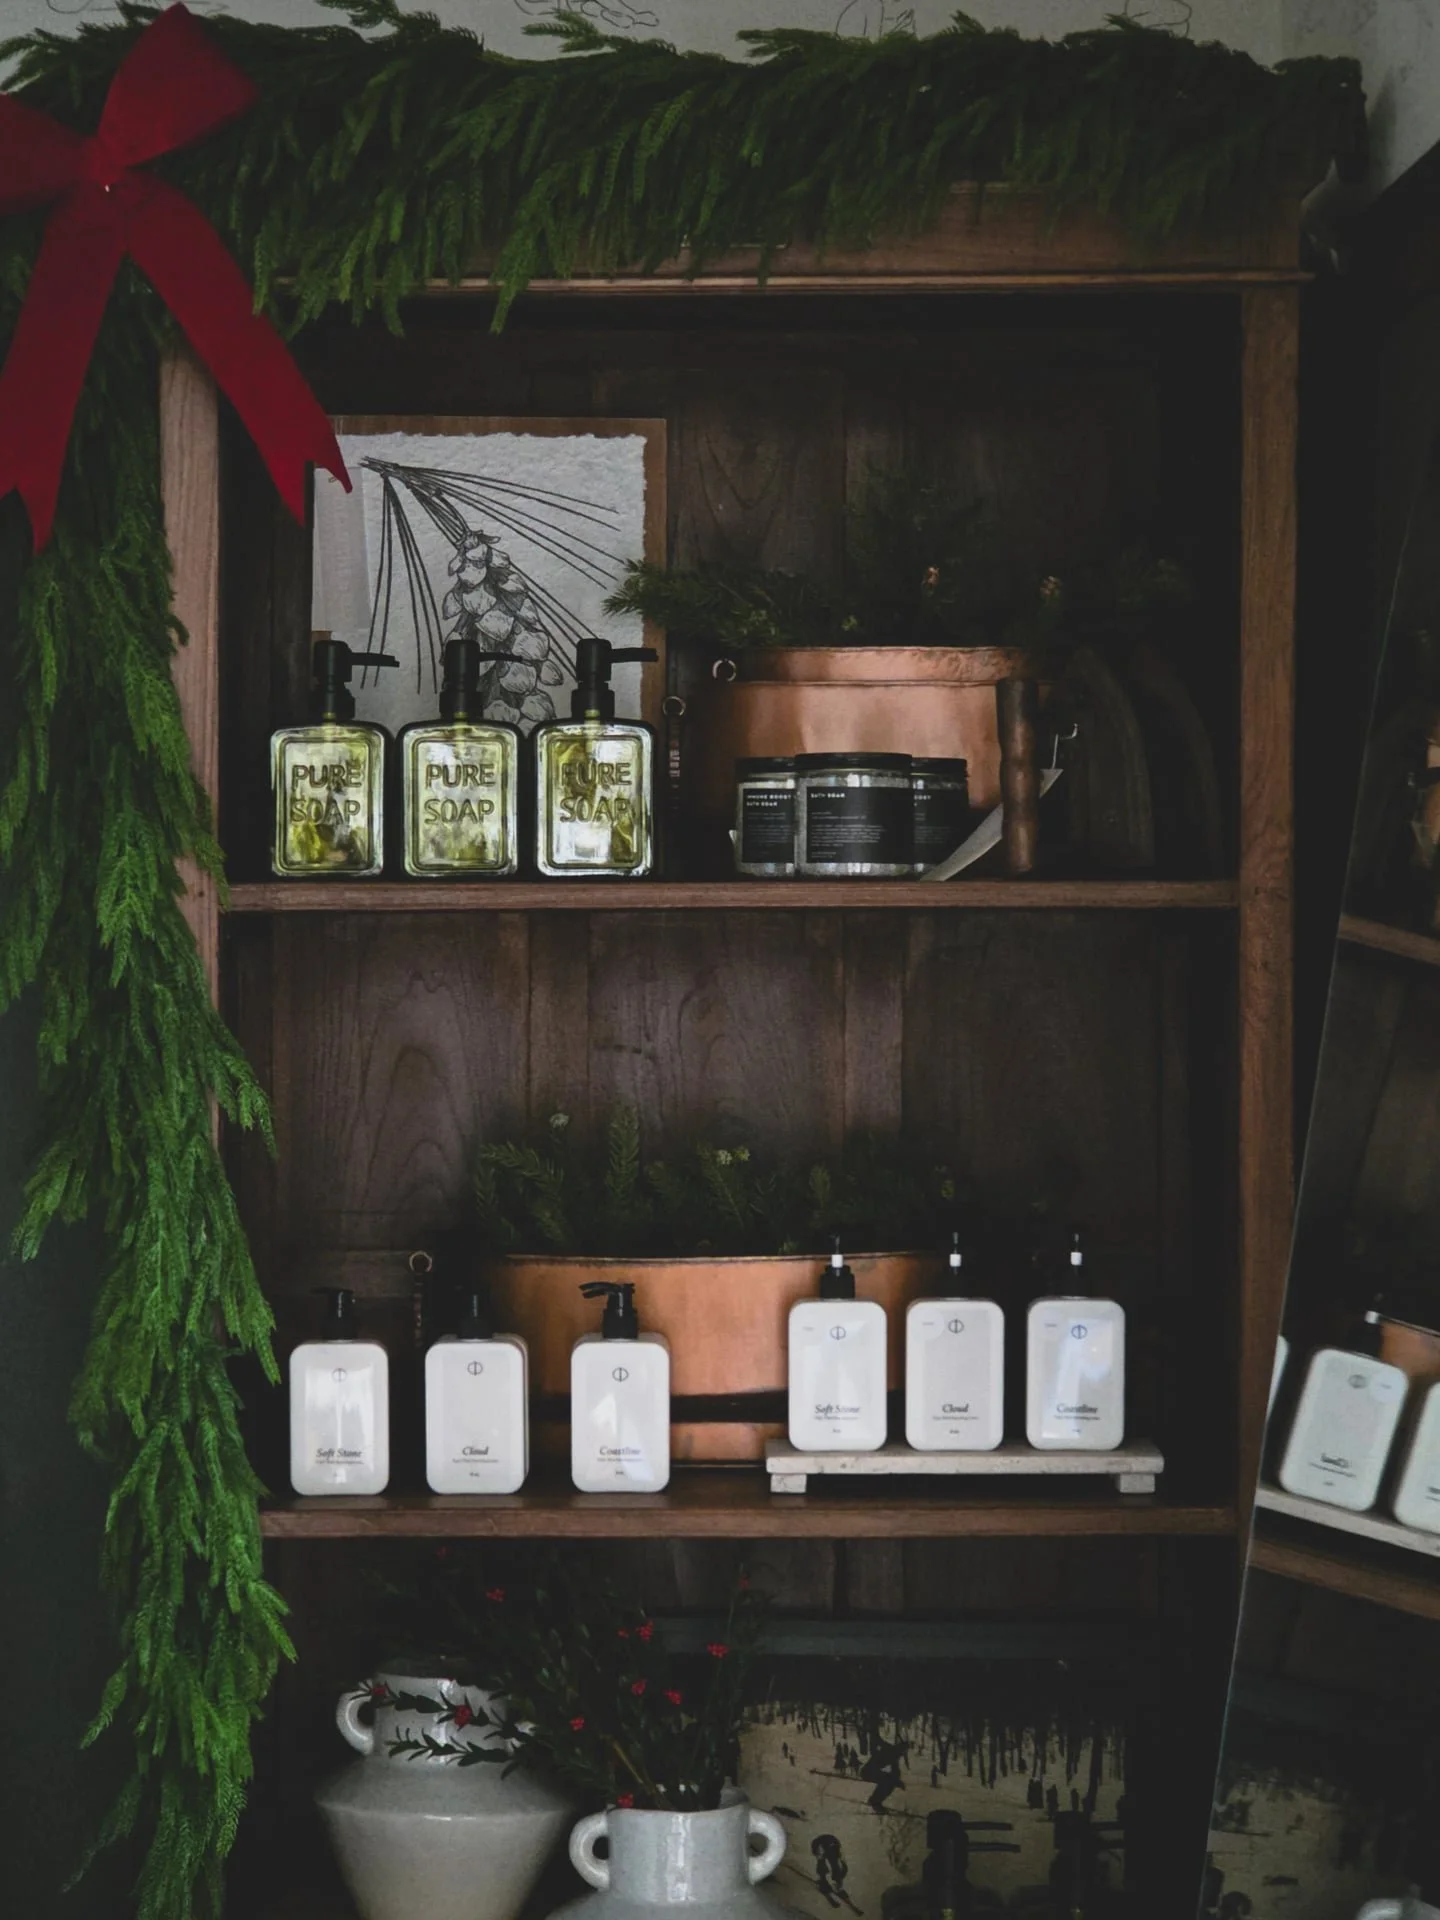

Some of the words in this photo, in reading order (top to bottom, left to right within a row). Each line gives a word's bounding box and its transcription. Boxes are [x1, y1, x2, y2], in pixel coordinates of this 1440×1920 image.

[291, 764, 362, 789] PURE
[425, 763, 496, 788] PURE
[561, 762, 631, 787] PURE
[291, 799, 361, 825] SOAP
[424, 799, 495, 825] SOAP
[560, 798, 631, 824] SOAP
[815, 1403, 834, 1417] Soft
[942, 1403, 969, 1413] Cloud
[315, 1447, 335, 1461] Soft
[462, 1445, 489, 1456] Cloud
